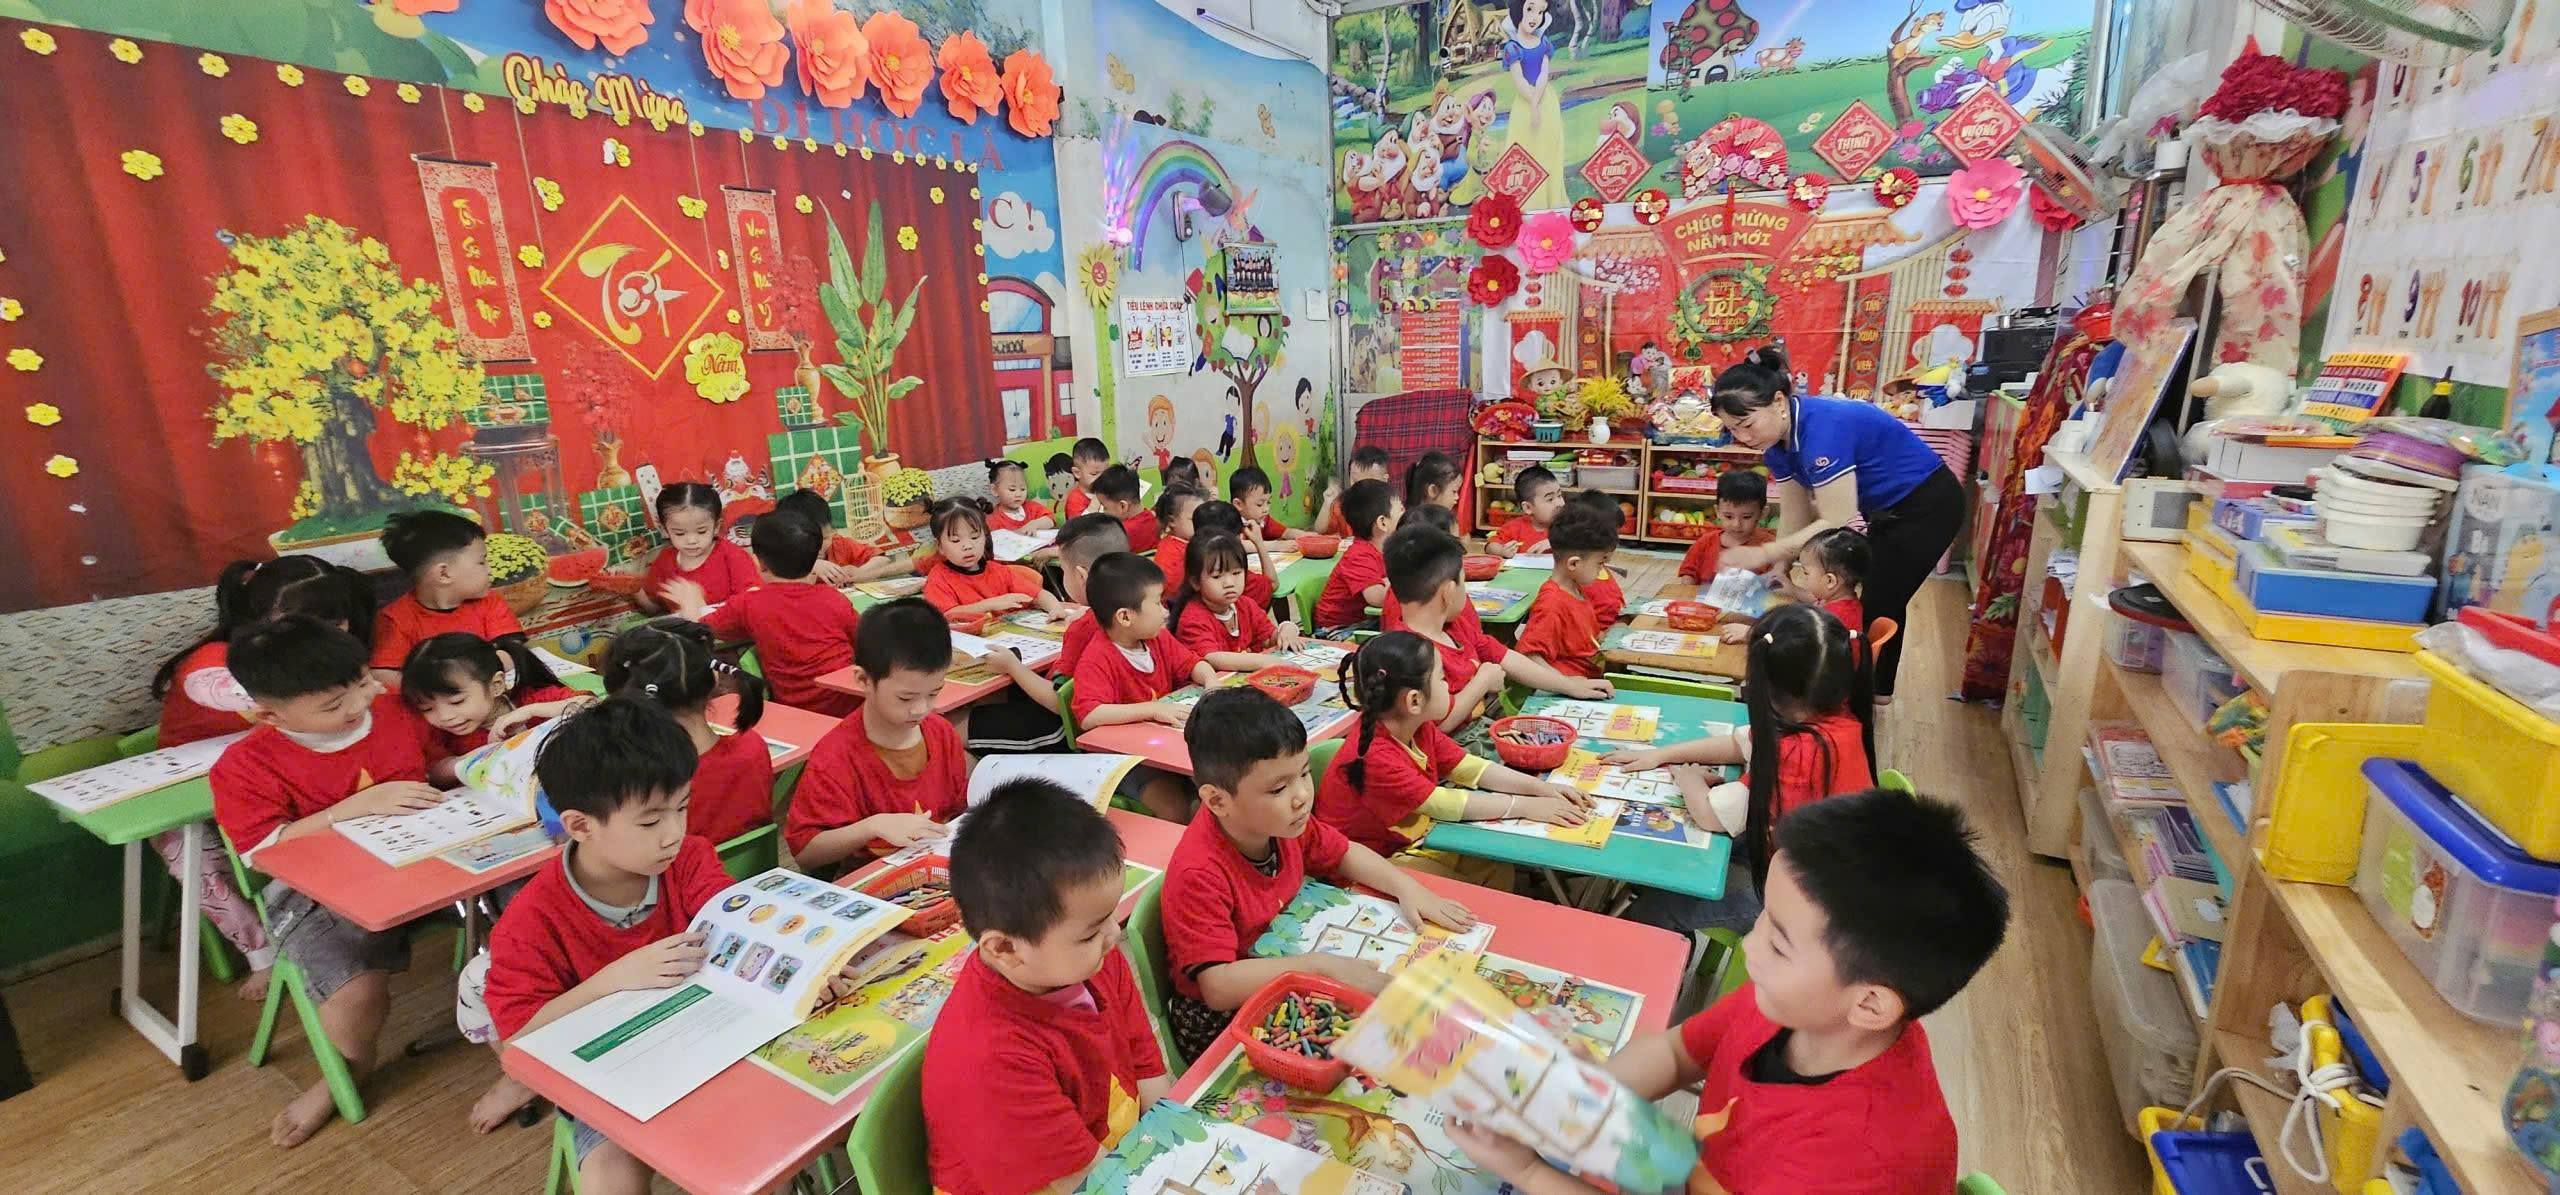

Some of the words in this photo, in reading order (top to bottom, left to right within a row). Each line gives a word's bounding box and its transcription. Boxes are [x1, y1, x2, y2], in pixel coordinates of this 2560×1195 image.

[1674, 213, 1724, 239] CHÚC
[1732, 207, 1791, 232] MỪNG
[1687, 234, 1728, 252] NĂM
[1733, 230, 1773, 246] MỚI
